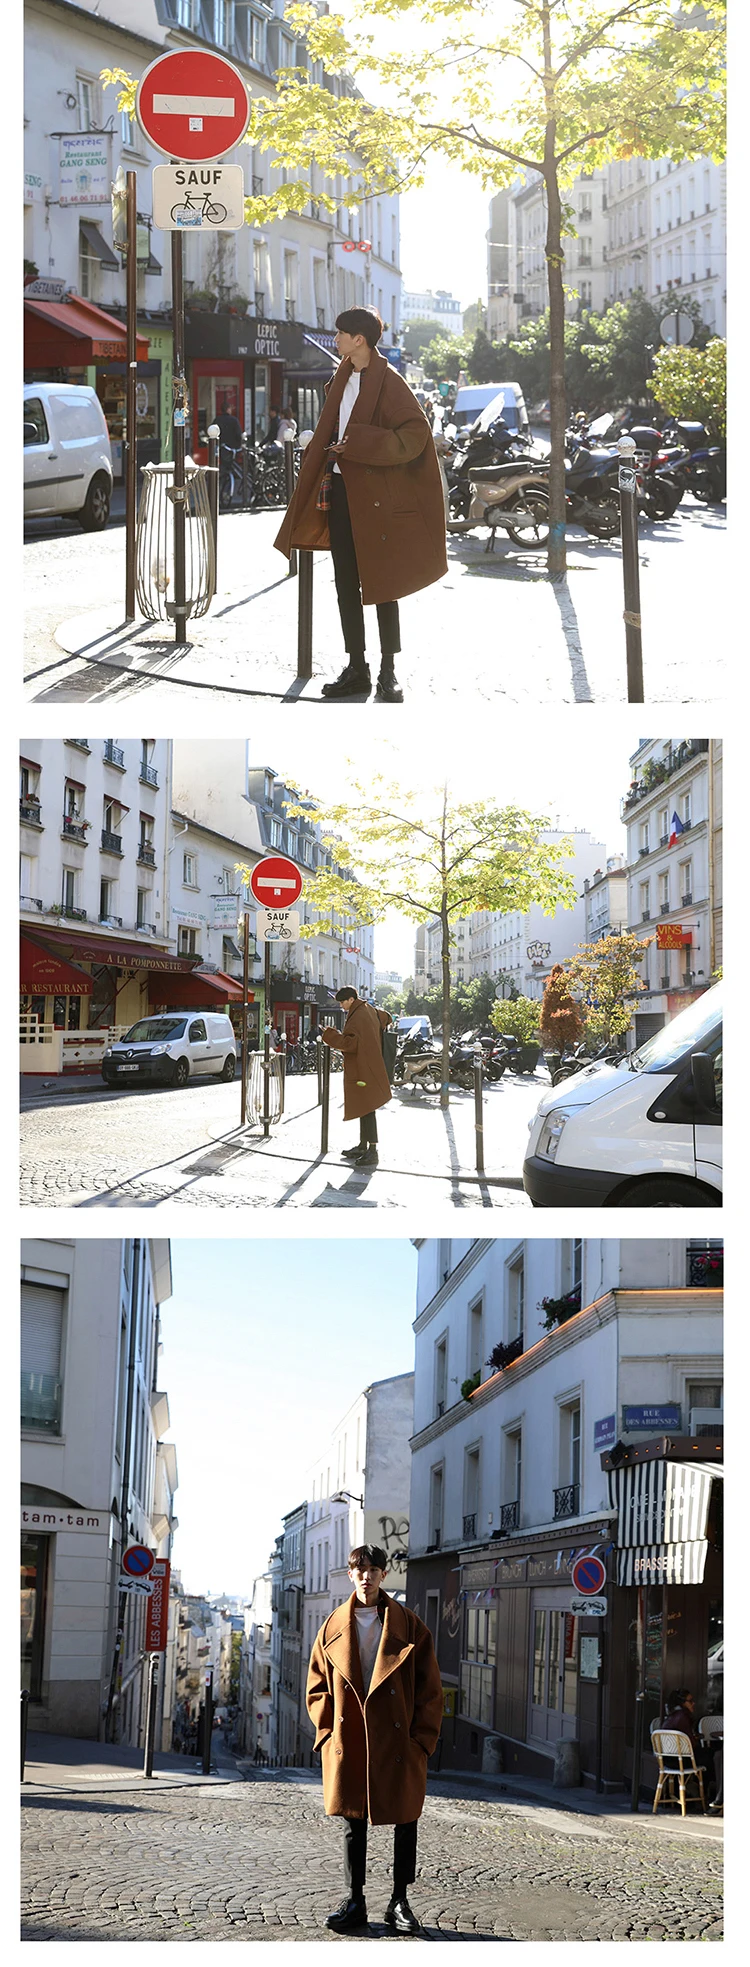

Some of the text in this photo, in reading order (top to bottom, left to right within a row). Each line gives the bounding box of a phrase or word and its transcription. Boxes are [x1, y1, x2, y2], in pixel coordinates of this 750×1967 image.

[60, 158, 107, 168] GANG SENG
[175, 170, 222, 185] SAUF
[257, 324, 277, 338] LEPIC
[254, 338, 280, 356] OPTIC
[267, 912, 289, 921] SAUF
[657, 925, 682, 935] VINS
[658, 940, 683, 949] ALCOOLS
[107, 953, 113, 963] A
[117, 955, 127, 965] LA
[131, 957, 182, 970] POMPONNETTE
[31, 983, 90, 993] RESTAURANT
[152, 1579, 163, 1628] ABBESSES
[151, 1630, 161, 1647] LES
